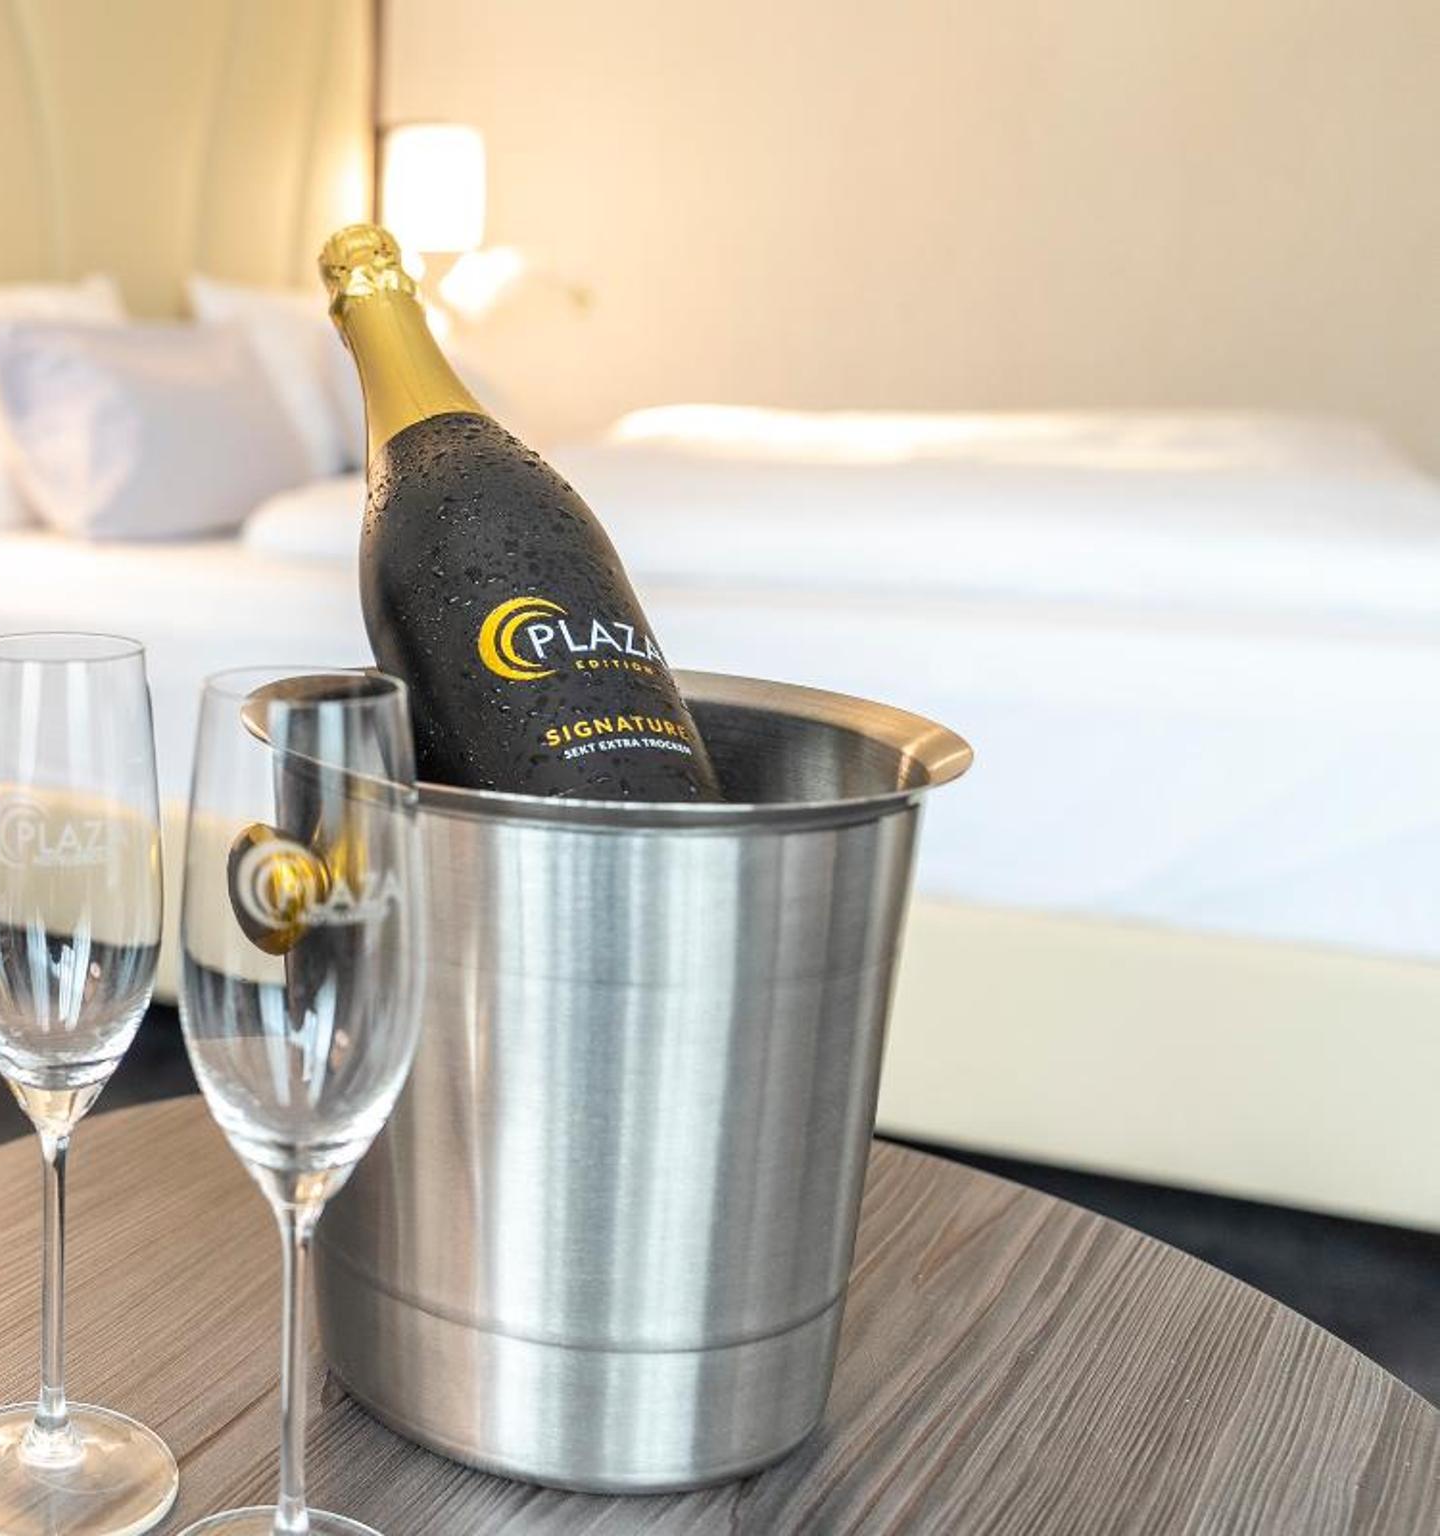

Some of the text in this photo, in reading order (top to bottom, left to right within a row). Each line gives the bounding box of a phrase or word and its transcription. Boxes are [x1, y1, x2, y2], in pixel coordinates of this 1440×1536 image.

[526, 618, 662, 660] PLAZA
[574, 659, 656, 676] EDITION
[545, 715, 690, 747] SIGNATURE
[563, 742, 596, 760] SEKT
[598, 738, 641, 752] EXTRA
